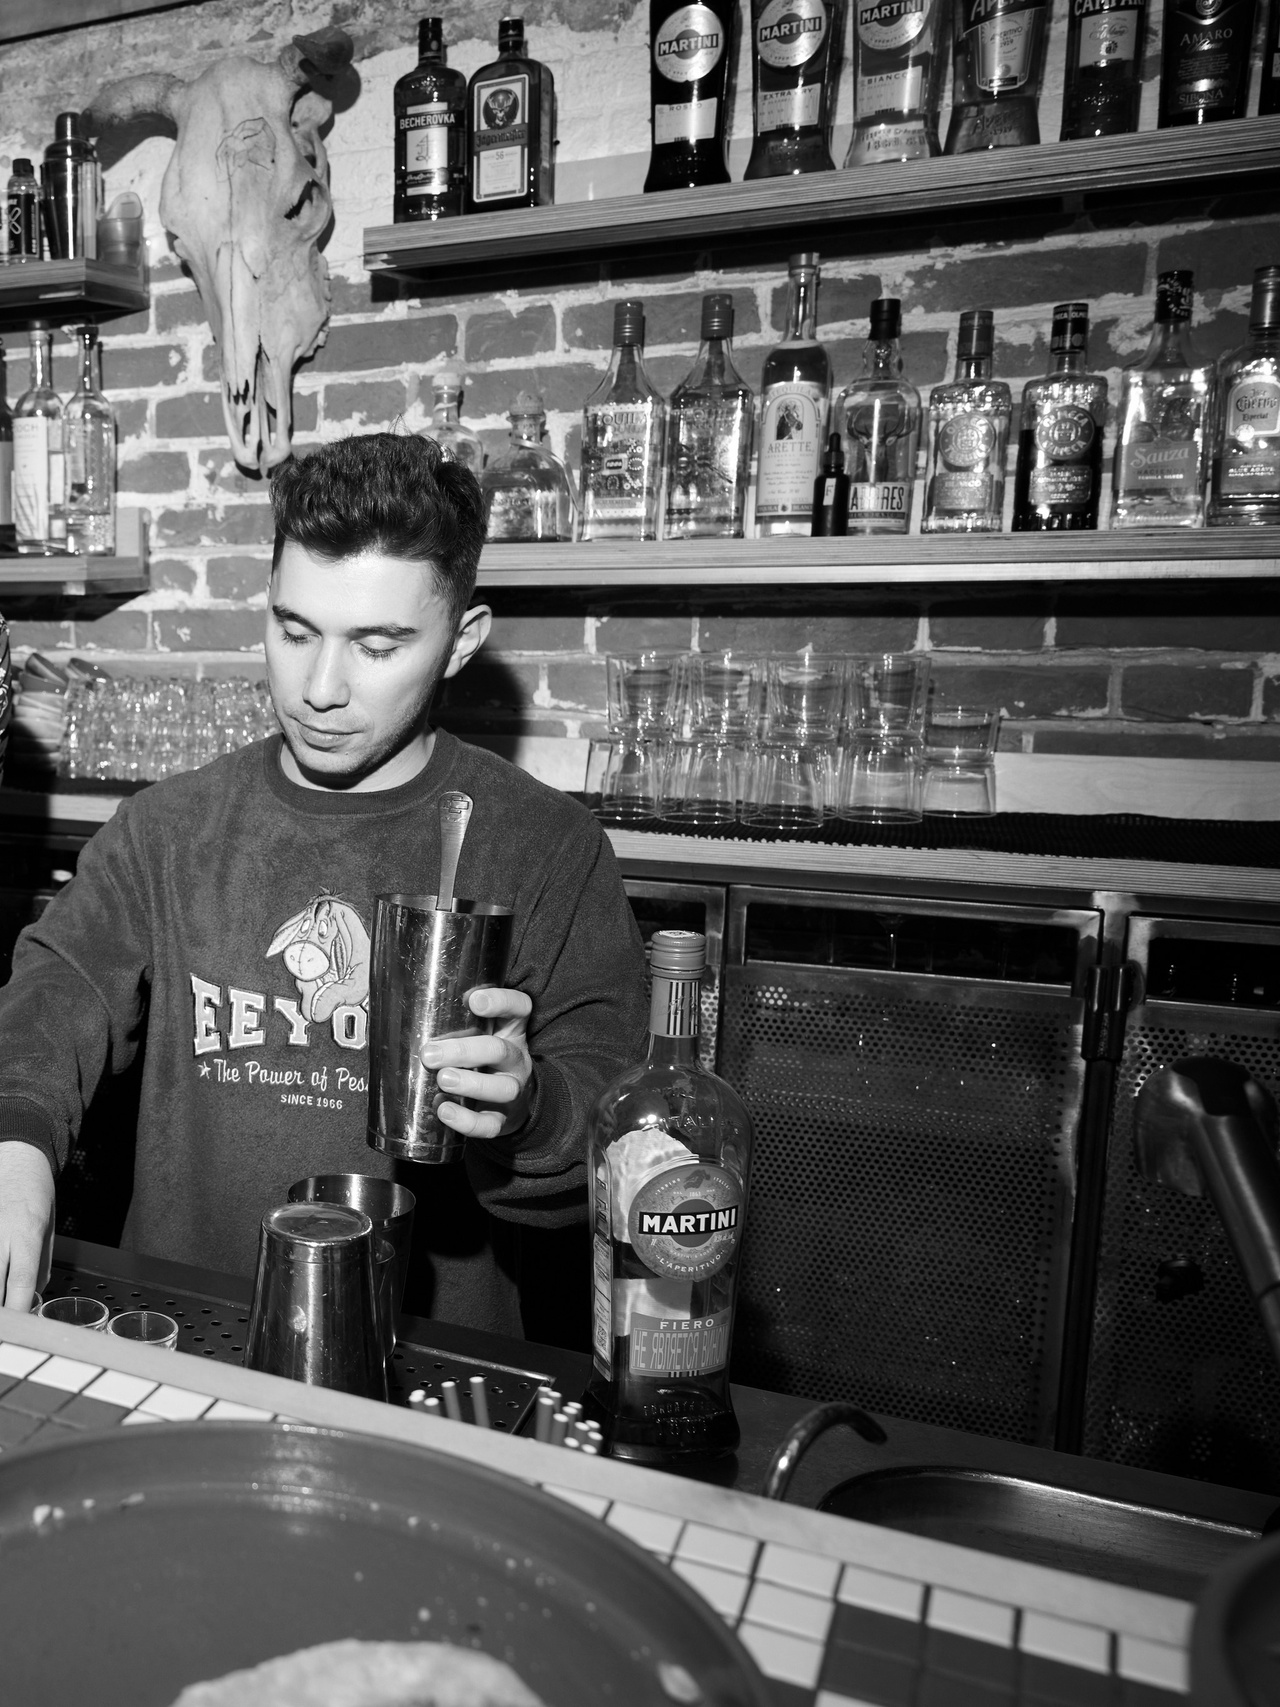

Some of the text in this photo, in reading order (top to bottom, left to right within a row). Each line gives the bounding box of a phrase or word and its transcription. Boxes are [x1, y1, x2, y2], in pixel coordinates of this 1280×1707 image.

[861, 0, 924, 23] MARTINI
[761, 18, 820, 41] MARTINI
[1180, 28, 1233, 46] AMARO
[660, 34, 717, 55] MARTINI
[763, 90, 791, 100] EXTRA
[669, 102, 703, 111] ROSO
[400, 113, 456, 129] BECHEROVKA
[767, 441, 812, 453] ARETTE
[1130, 448, 1189, 468] Sauza
[851, 486, 905, 511] ARES
[190, 973, 368, 1056] EEYO
[213, 1059, 368, 1092] The Power of Pes
[280, 1094, 343, 1109] SINCE 1966
[642, 1208, 736, 1233] MARTINI
[659, 1253, 721, 1273] L'APERITIVO
[660, 1318, 714, 1330] FIERO
[632, 1329, 648, 1368] НЕ
[650, 1331, 700, 1370] ЯВЛЯЕТСЯ
